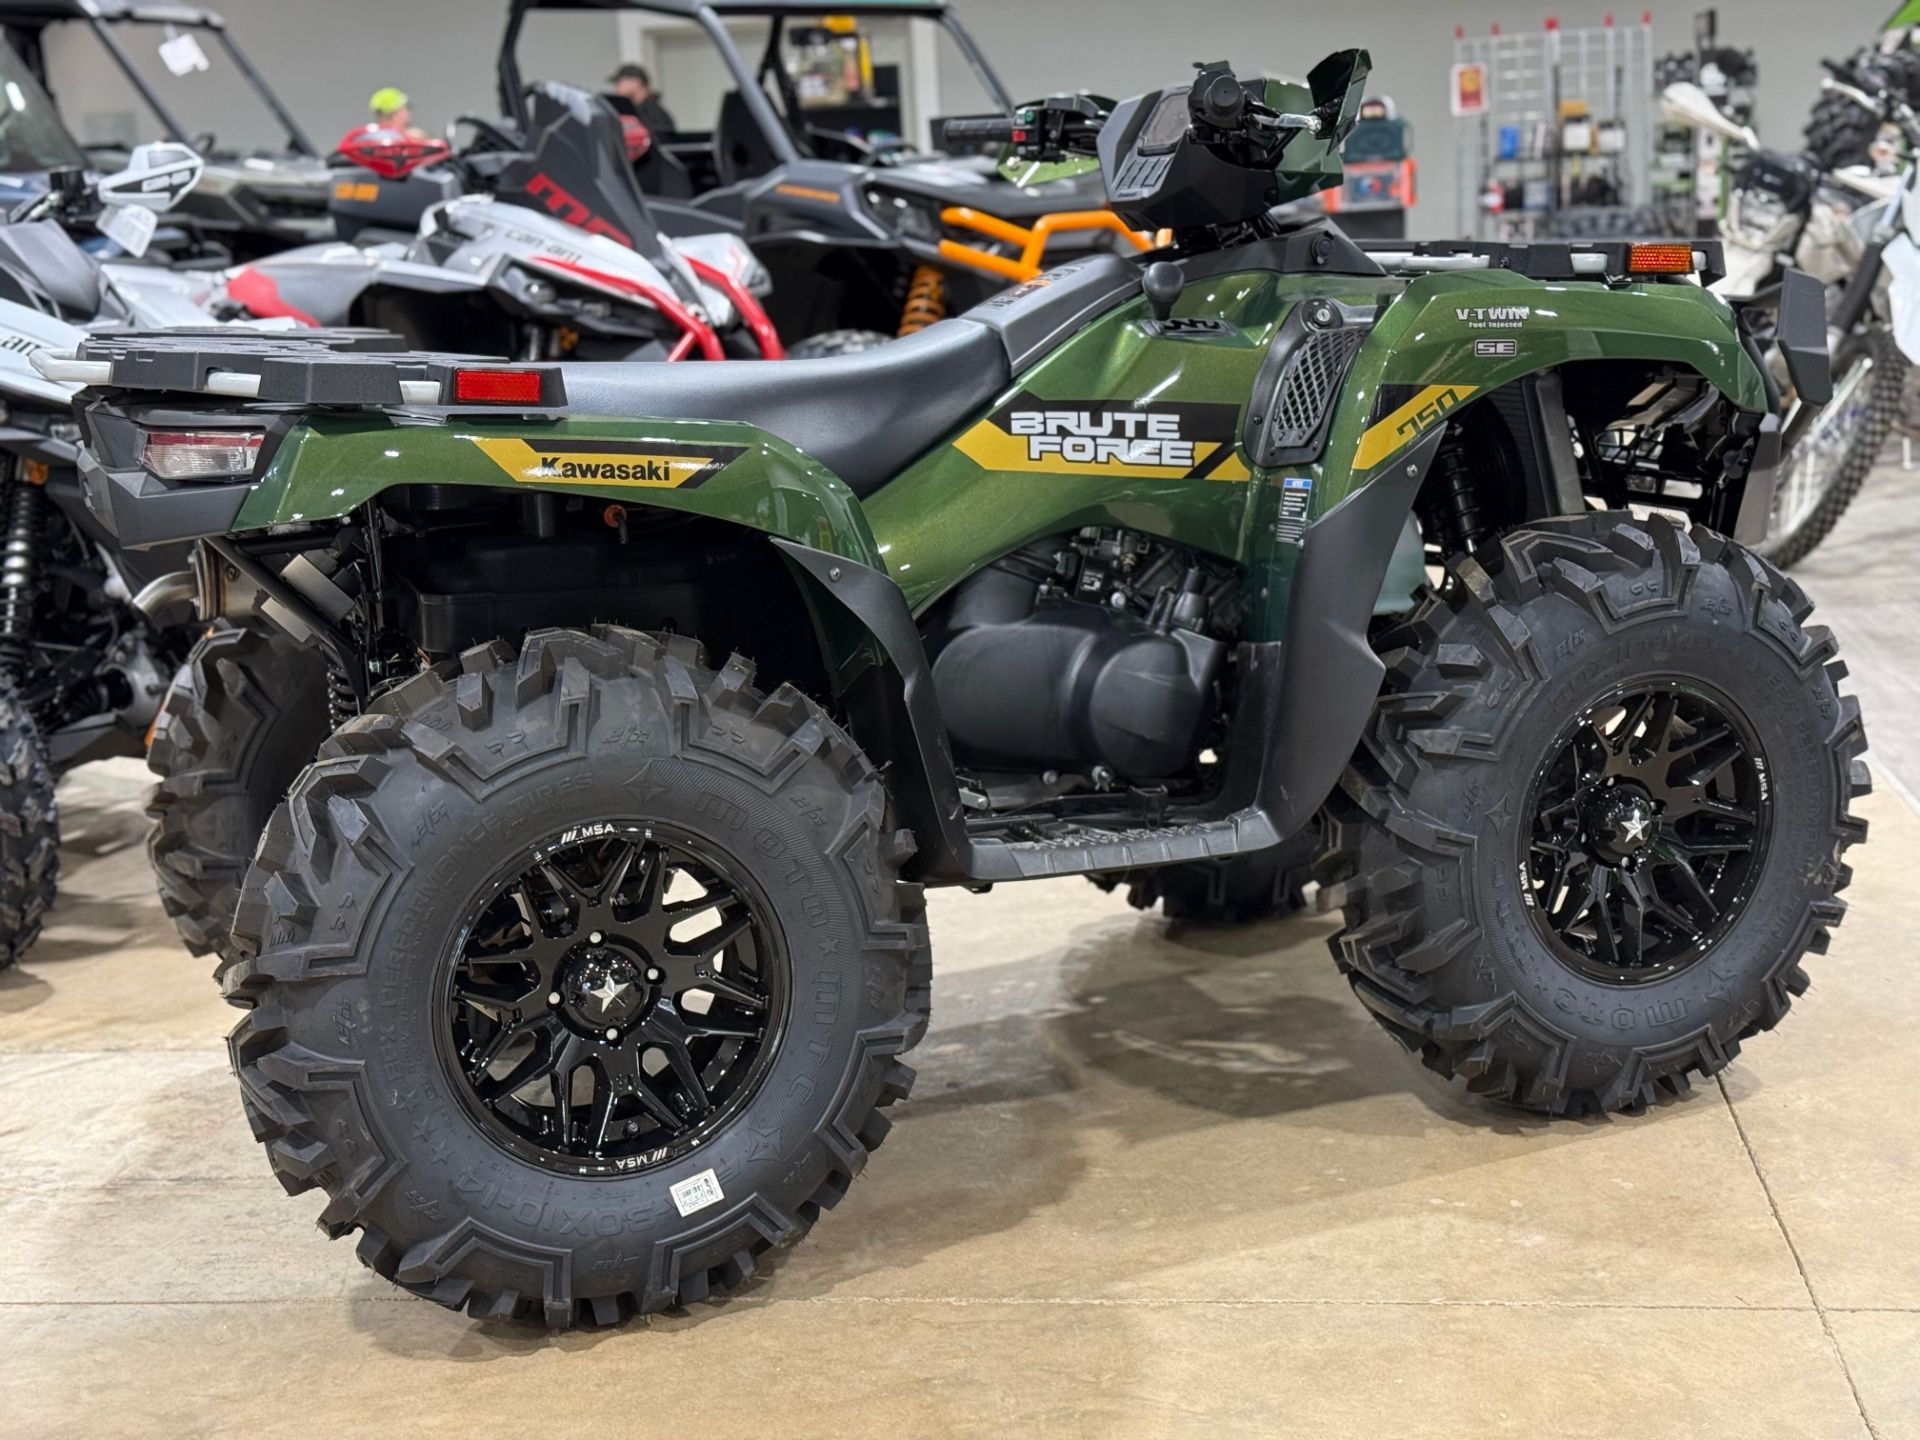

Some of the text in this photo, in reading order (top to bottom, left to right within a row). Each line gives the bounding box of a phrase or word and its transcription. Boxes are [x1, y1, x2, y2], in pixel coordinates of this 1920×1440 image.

[1455, 307, 1529, 320] V-TWIN
[1488, 321, 1523, 329] Injected
[1477, 342, 1515, 354] SE
[1010, 411, 1181, 439] BRUTE
[1396, 388, 1460, 438] 750
[1029, 435, 1195, 466] FORCE
[540, 457, 670, 481] Kawasaki
[1758, 773, 1768, 800] MSA
[581, 823, 615, 838] MSA
[1519, 861, 1529, 890] MSA
[615, 1154, 648, 1170] MSA
